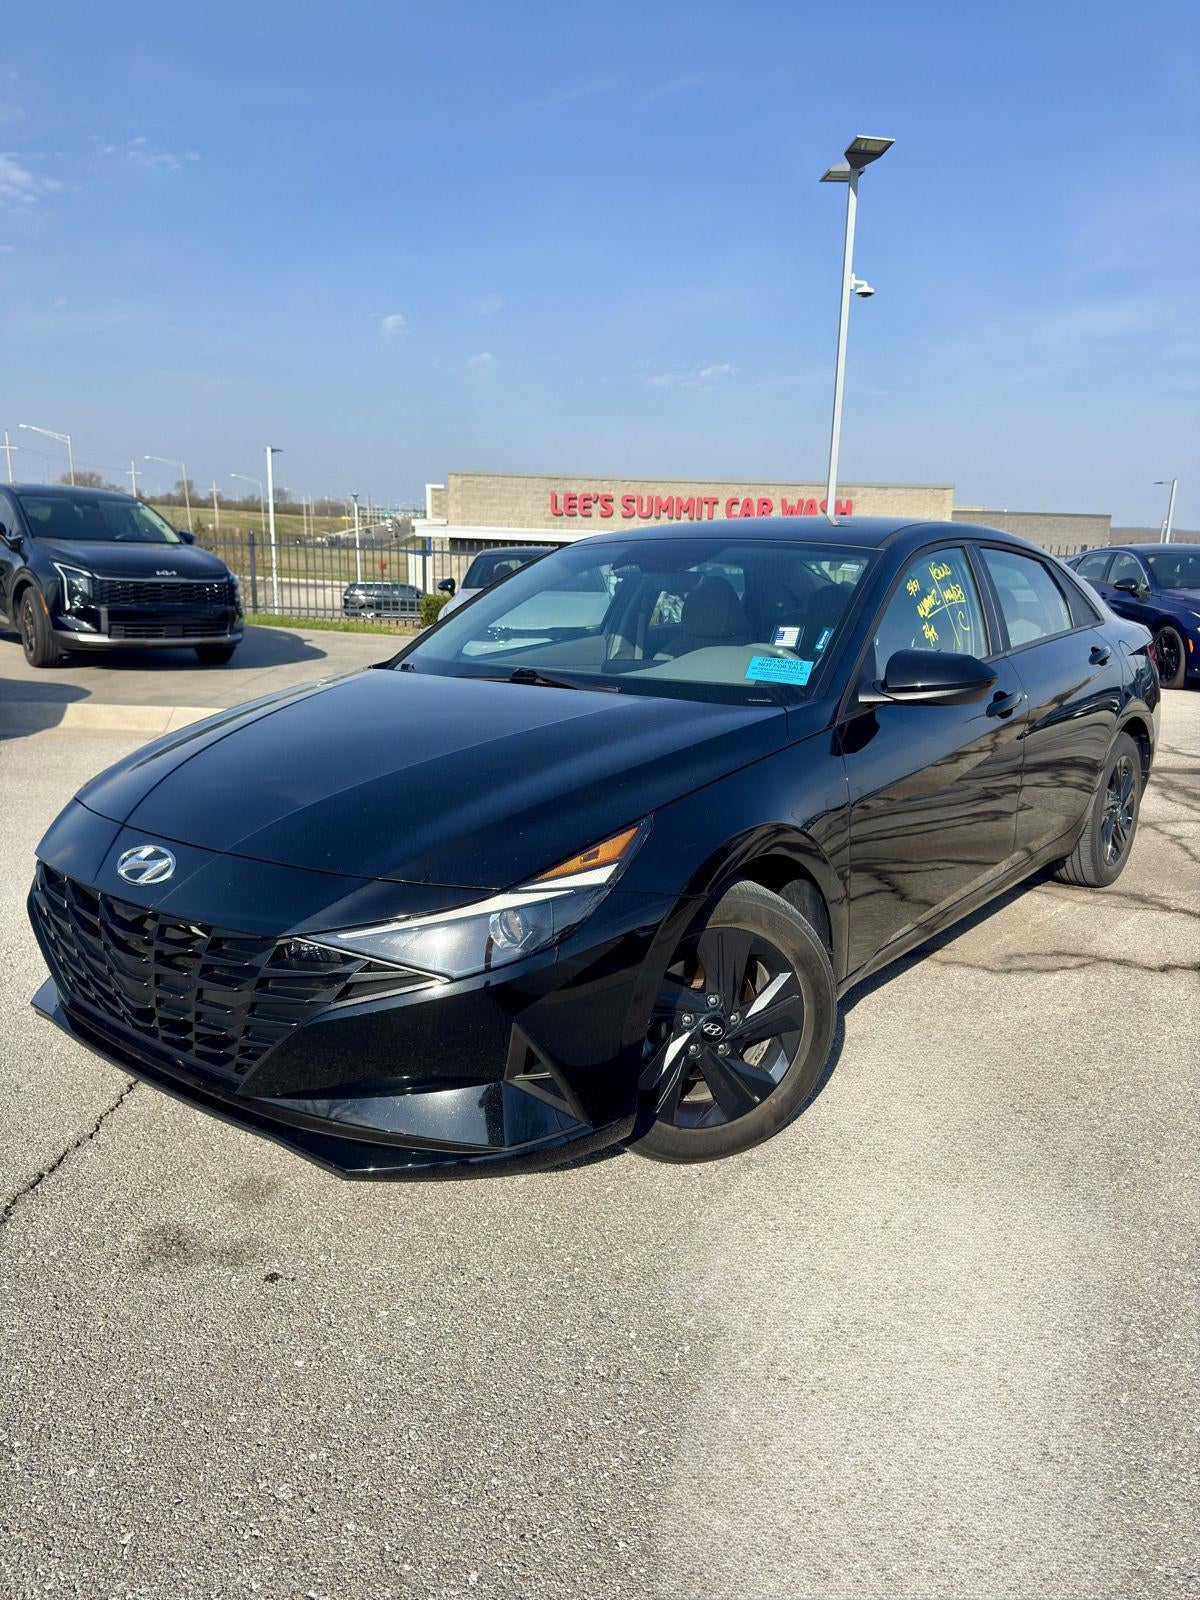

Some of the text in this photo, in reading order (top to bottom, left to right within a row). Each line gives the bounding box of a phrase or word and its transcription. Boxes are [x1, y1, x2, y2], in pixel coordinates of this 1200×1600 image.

[550, 491, 614, 517] LEE'S
[620, 494, 719, 520] SUMMIT
[725, 497, 773, 518] CAR
[777, 659, 804, 667] VEHICLE
